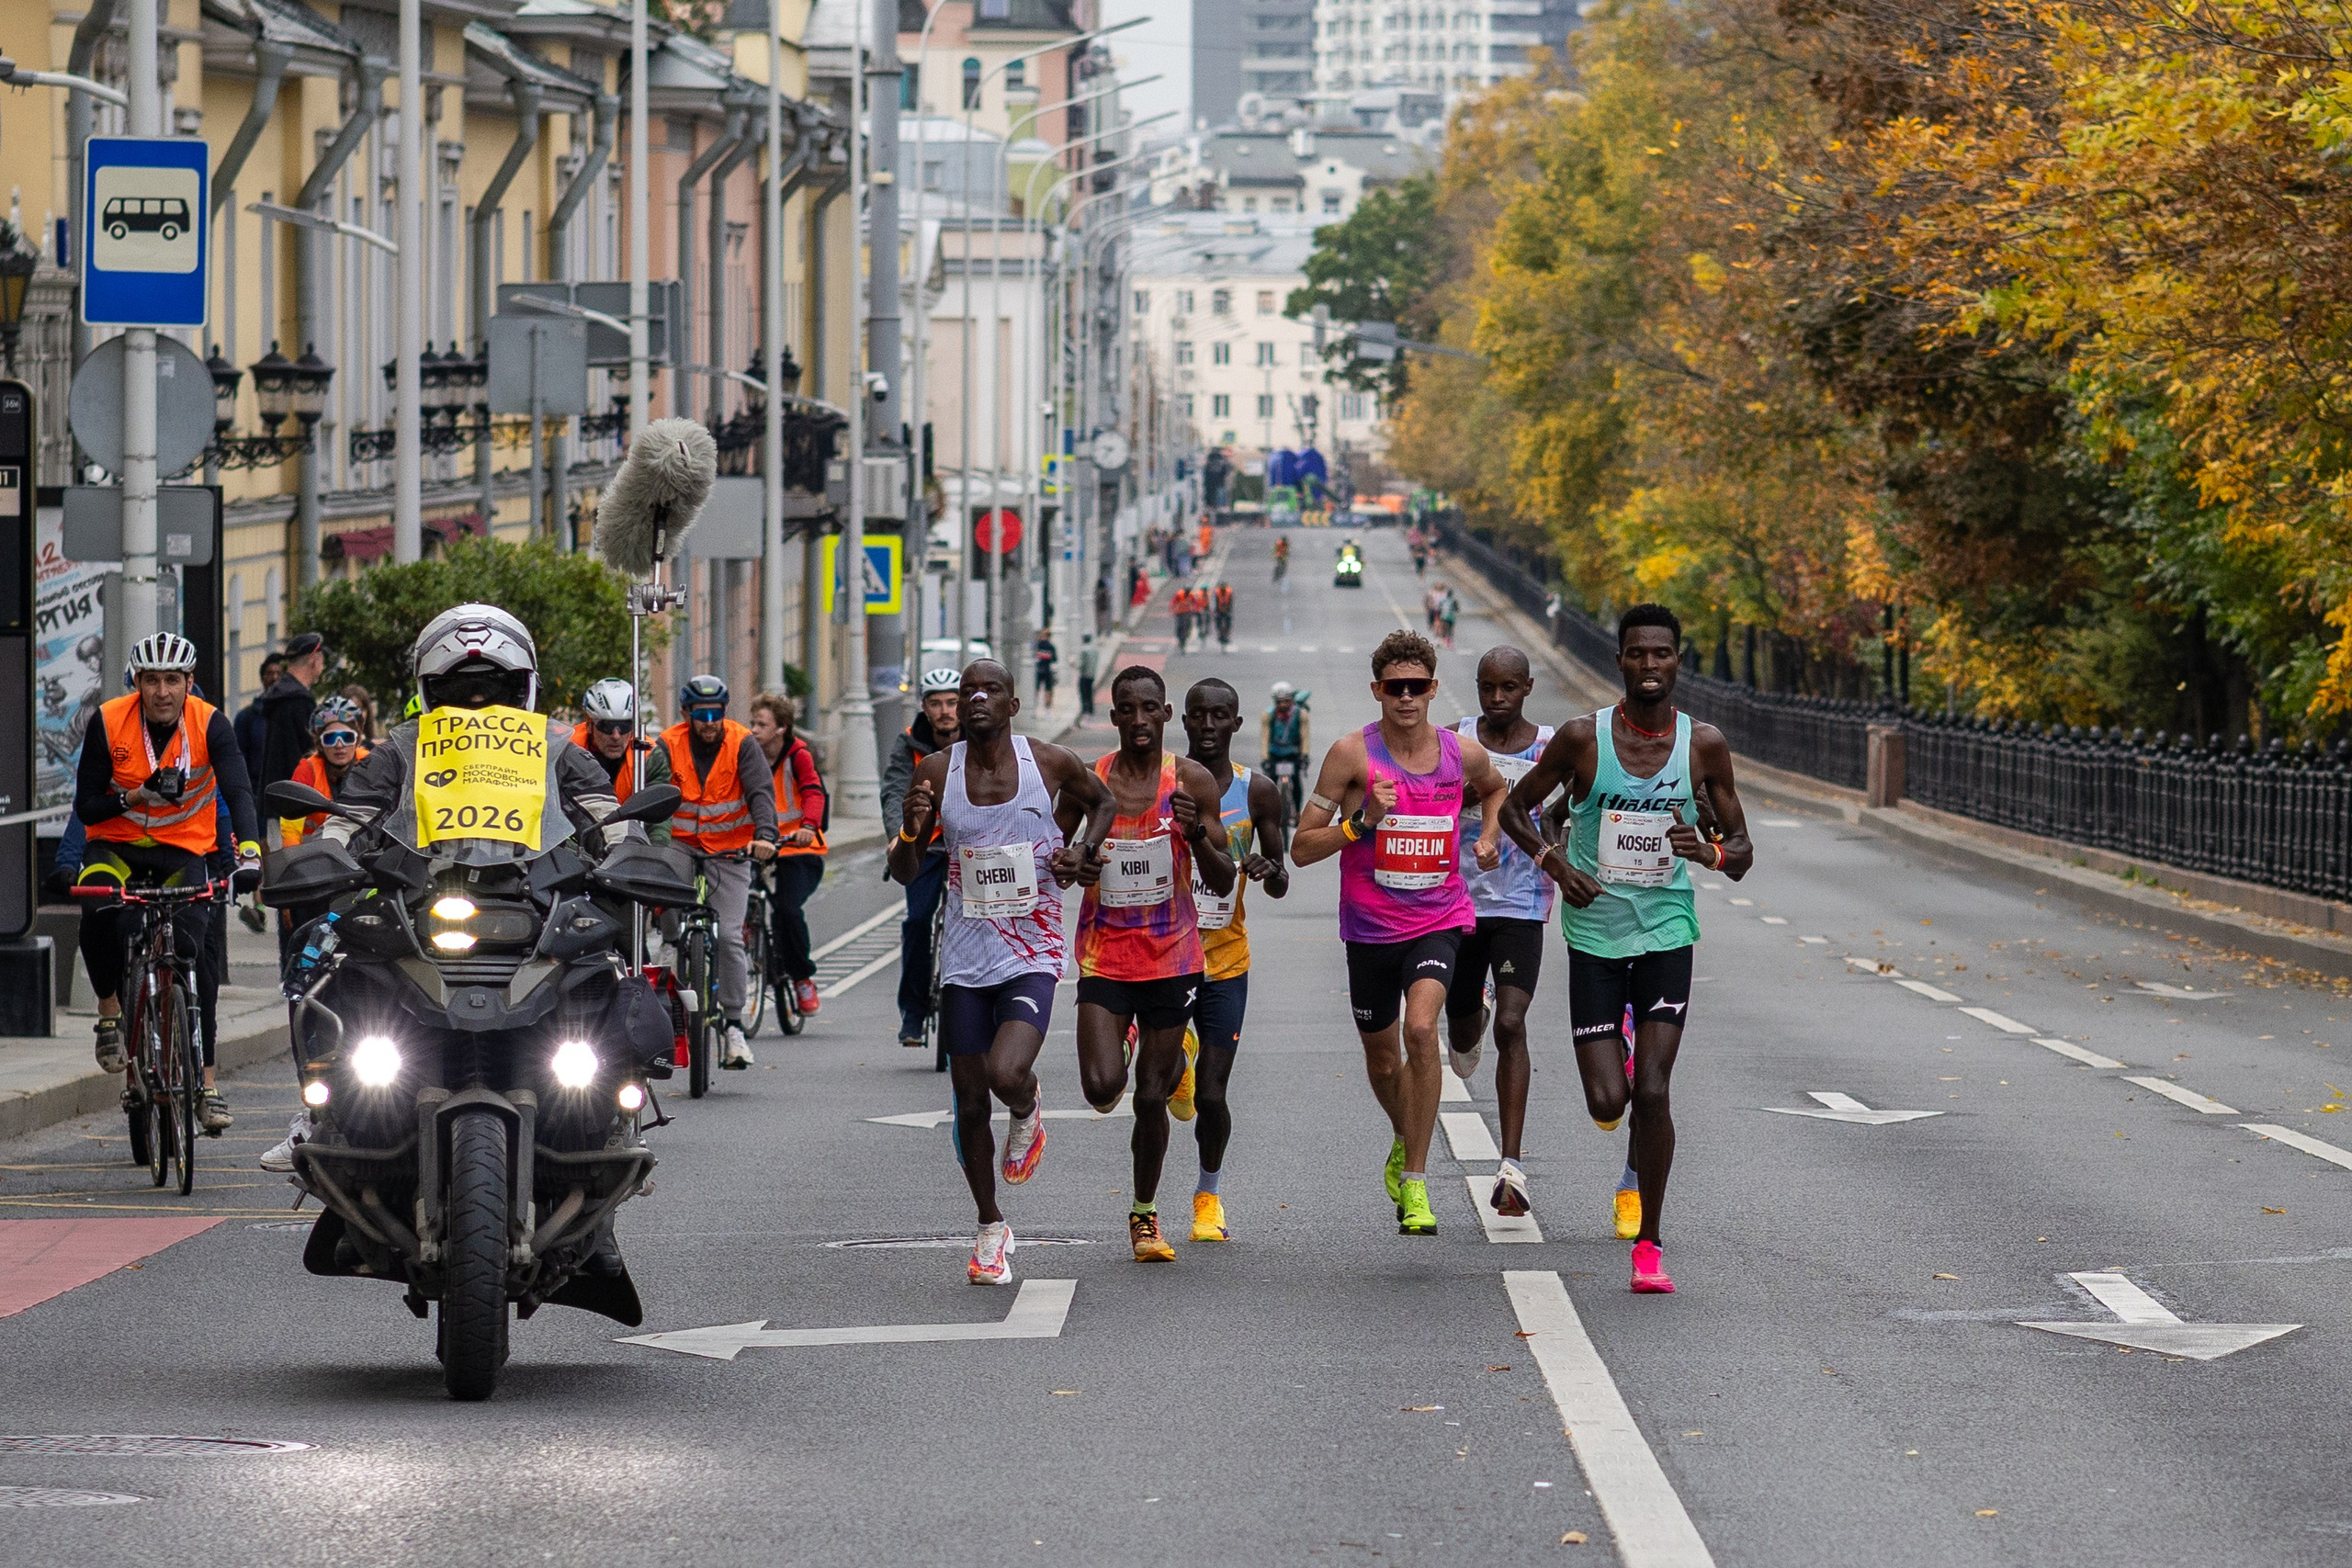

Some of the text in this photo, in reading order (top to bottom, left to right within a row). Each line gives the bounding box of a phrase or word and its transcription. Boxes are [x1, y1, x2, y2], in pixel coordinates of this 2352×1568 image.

[432, 716, 533, 735] ТРАССА
[422, 734, 542, 758] ПРОПУСК
[462, 770, 537, 786] МОСКОВСКИЙ
[463, 763, 518, 775] СБЕРПРАЙМ
[462, 777, 518, 788] МАРАФОН
[435, 806, 524, 831] 2026
[1385, 838, 1444, 856] NEDELIN
[1617, 834, 1662, 852] KOSGEI
[976, 867, 1016, 885] CHEBII
[1121, 860, 1150, 875] KIBII
[1573, 1023, 1615, 1037] HIRACER
